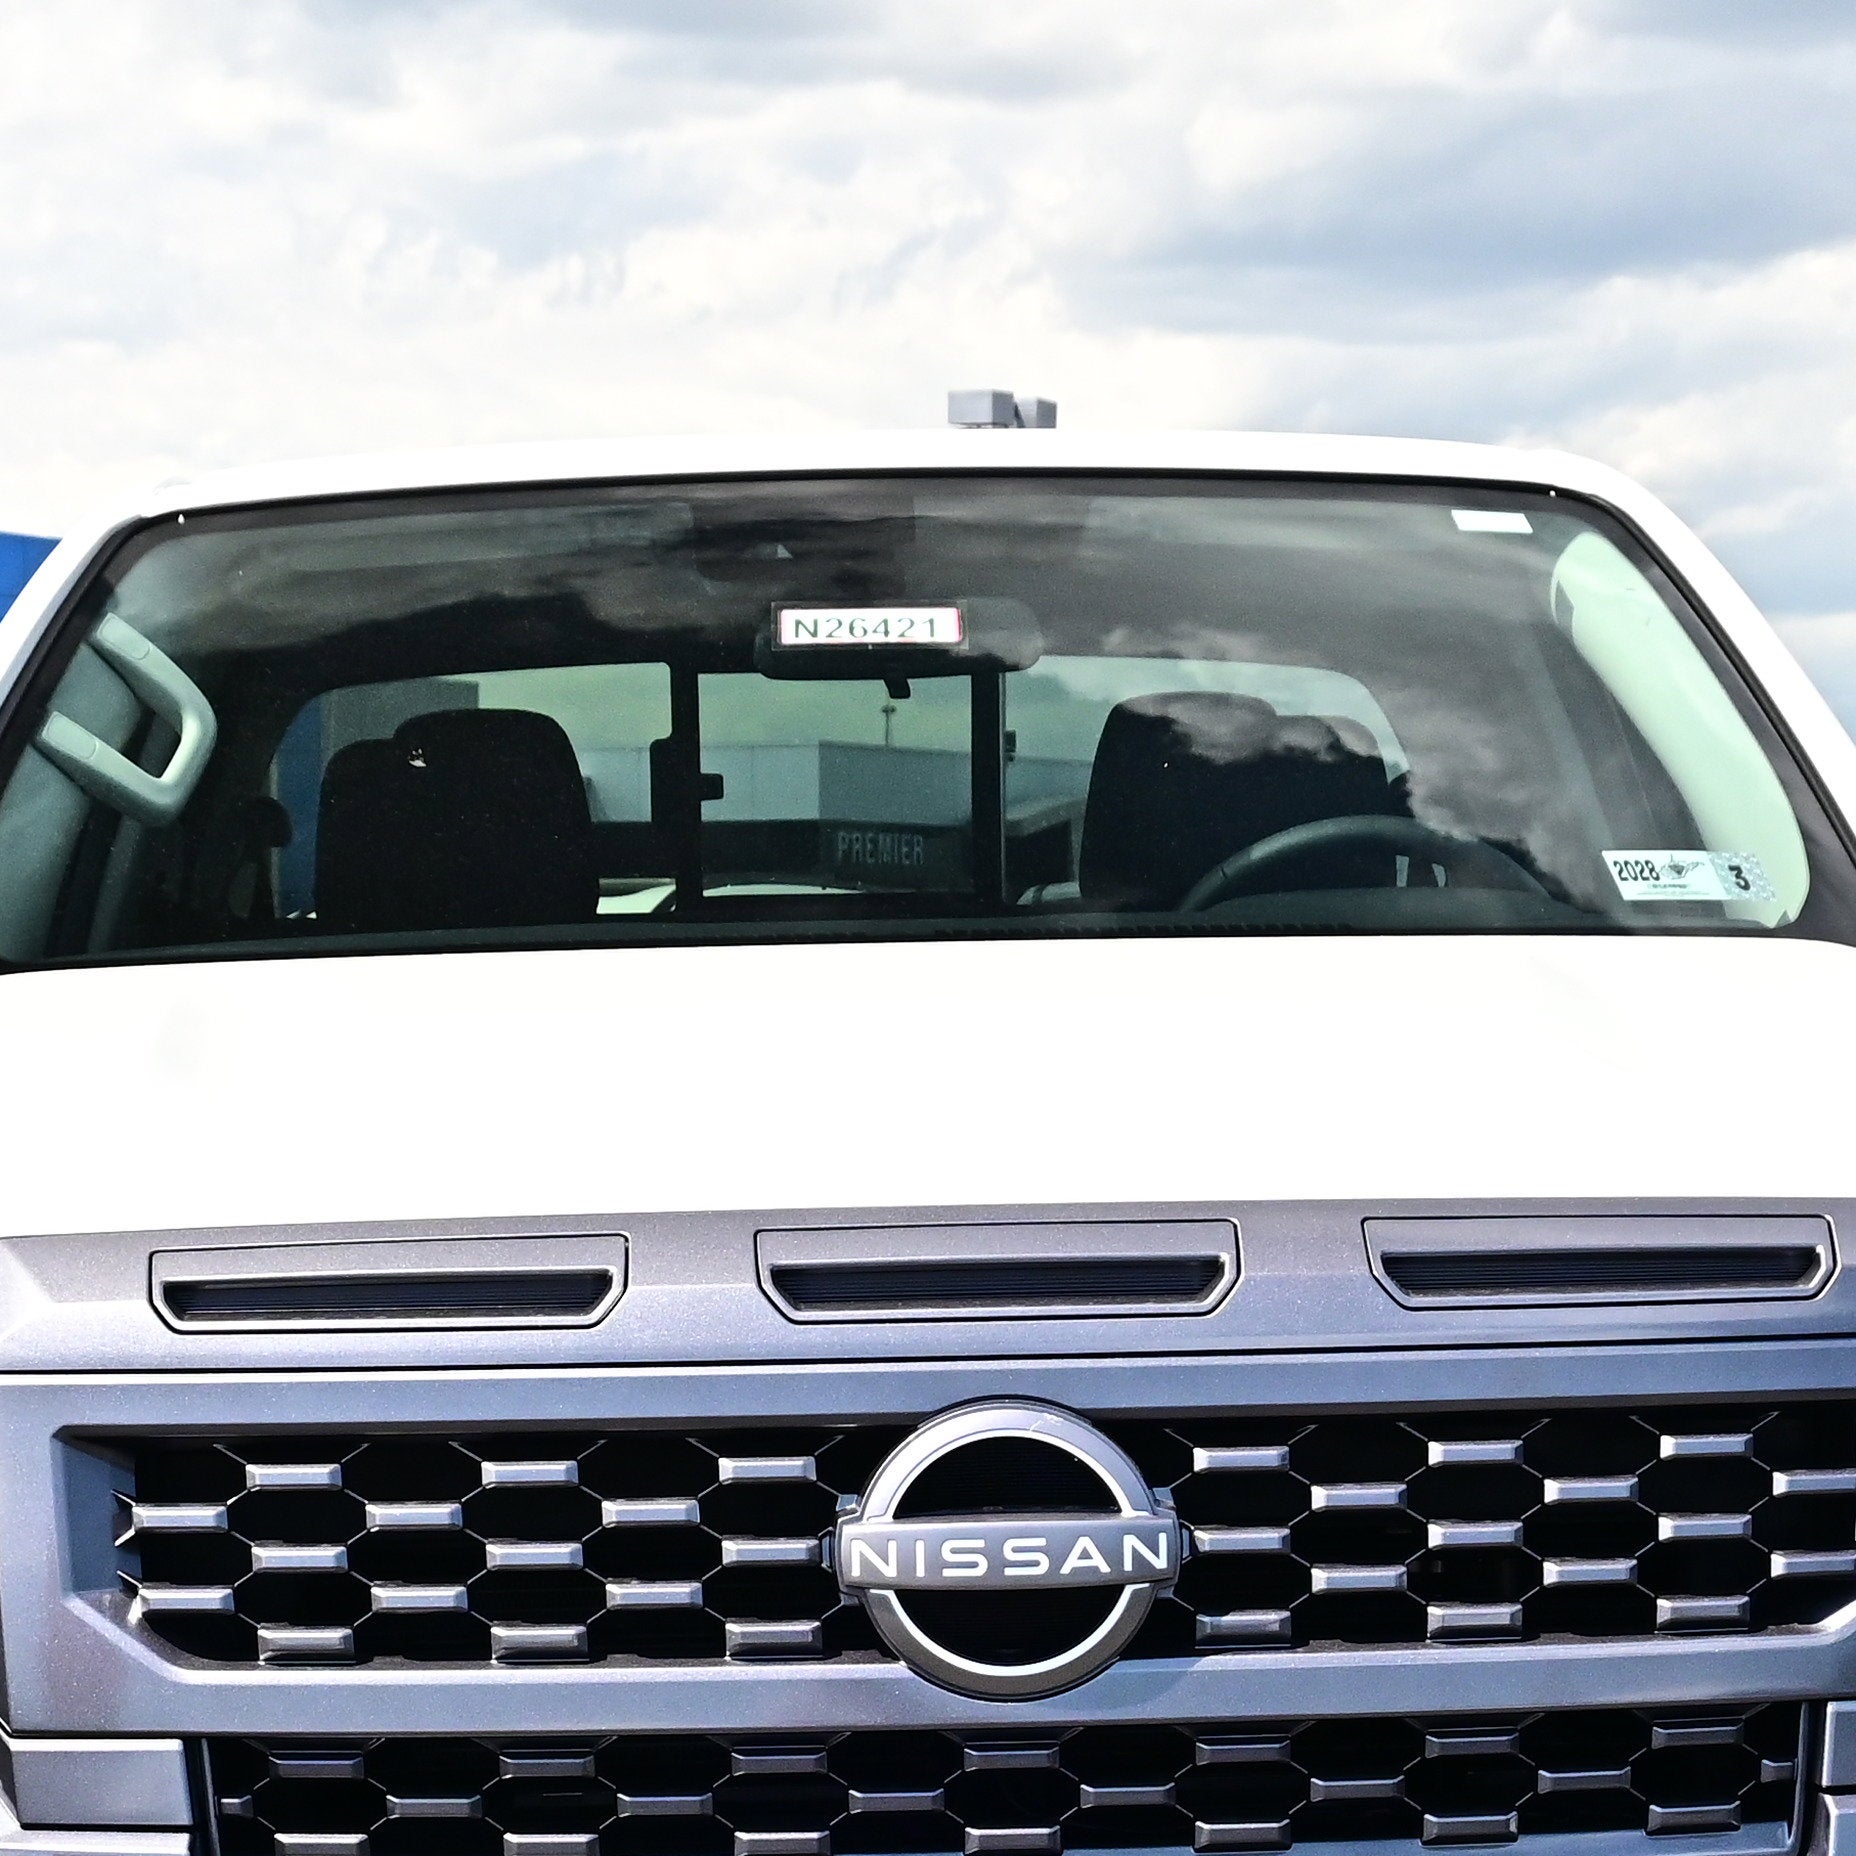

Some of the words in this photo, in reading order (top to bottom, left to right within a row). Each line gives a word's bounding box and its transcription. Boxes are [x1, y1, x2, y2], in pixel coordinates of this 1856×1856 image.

[794, 617, 935, 639] N26421
[836, 831, 924, 865] PREMIER
[1613, 860, 1660, 882] 2028
[1727, 864, 1751, 892] 3
[850, 1532, 1169, 1578] NISSAN
